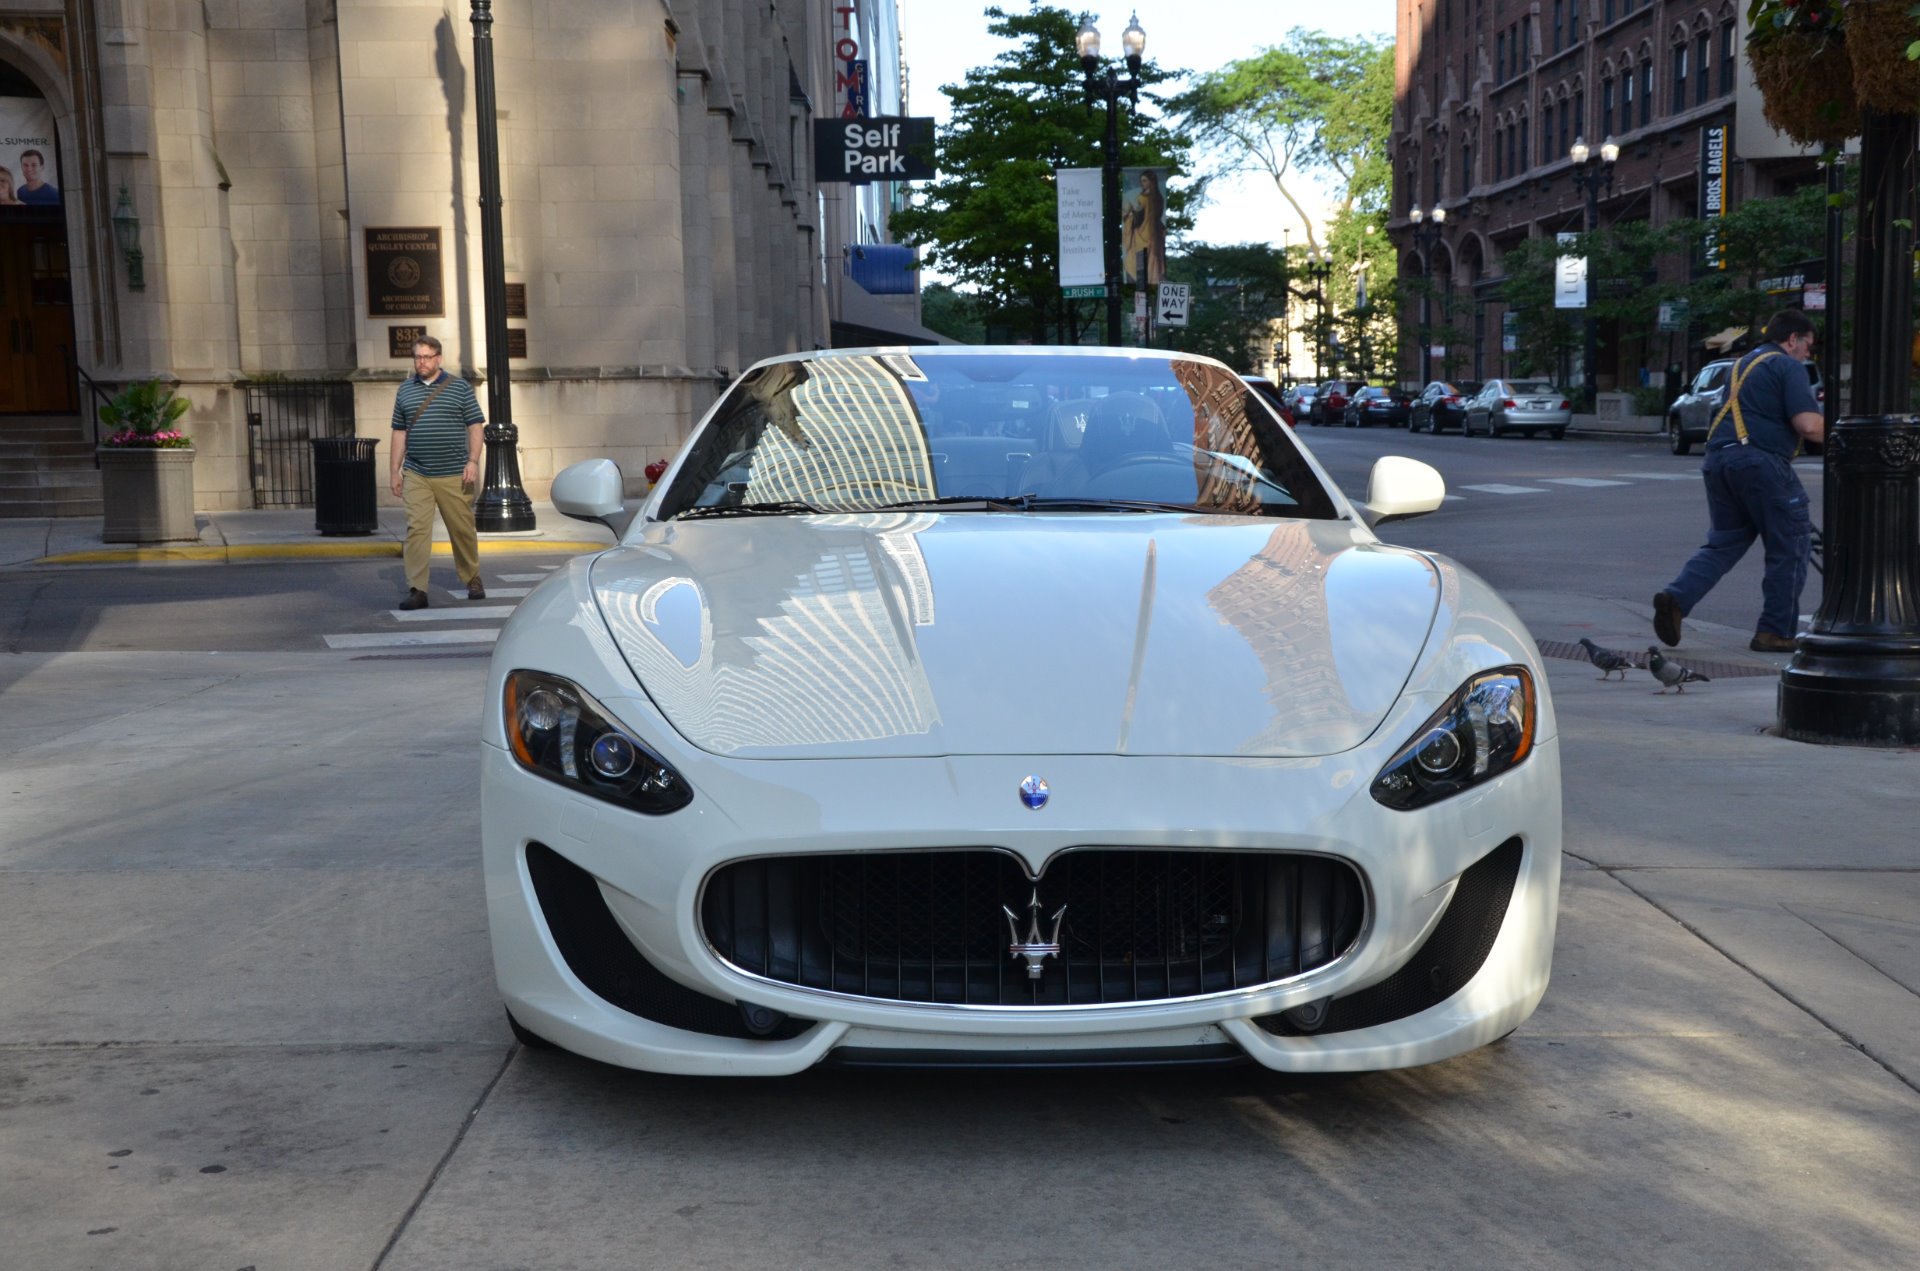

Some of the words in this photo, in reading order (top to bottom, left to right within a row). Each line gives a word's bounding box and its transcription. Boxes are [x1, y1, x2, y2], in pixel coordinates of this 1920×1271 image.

[845, 123, 900, 148] Self
[1708, 128, 1723, 174] BAGELS
[845, 149, 905, 174] Park
[1062, 187, 1080, 195] Take
[1062, 199, 1074, 208] the
[1076, 199, 1094, 208] Year
[1062, 210, 1070, 219] of
[1072, 210, 1097, 220] Mercy
[1062, 223, 1078, 231] tour
[1080, 223, 1088, 231] at
[376, 233, 429, 241] ARCHBISHOP
[1063, 234, 1075, 242] the
[1077, 234, 1091, 242] Art
[368, 243, 404, 251] QUIGLEY
[405, 242, 438, 250] CENTER
[1063, 245, 1097, 255] Institute
[1072, 288, 1095, 297] RUSH
[1162, 286, 1186, 298] ONE
[1161, 297, 1185, 309] WAY
[396, 328, 419, 342] 835
